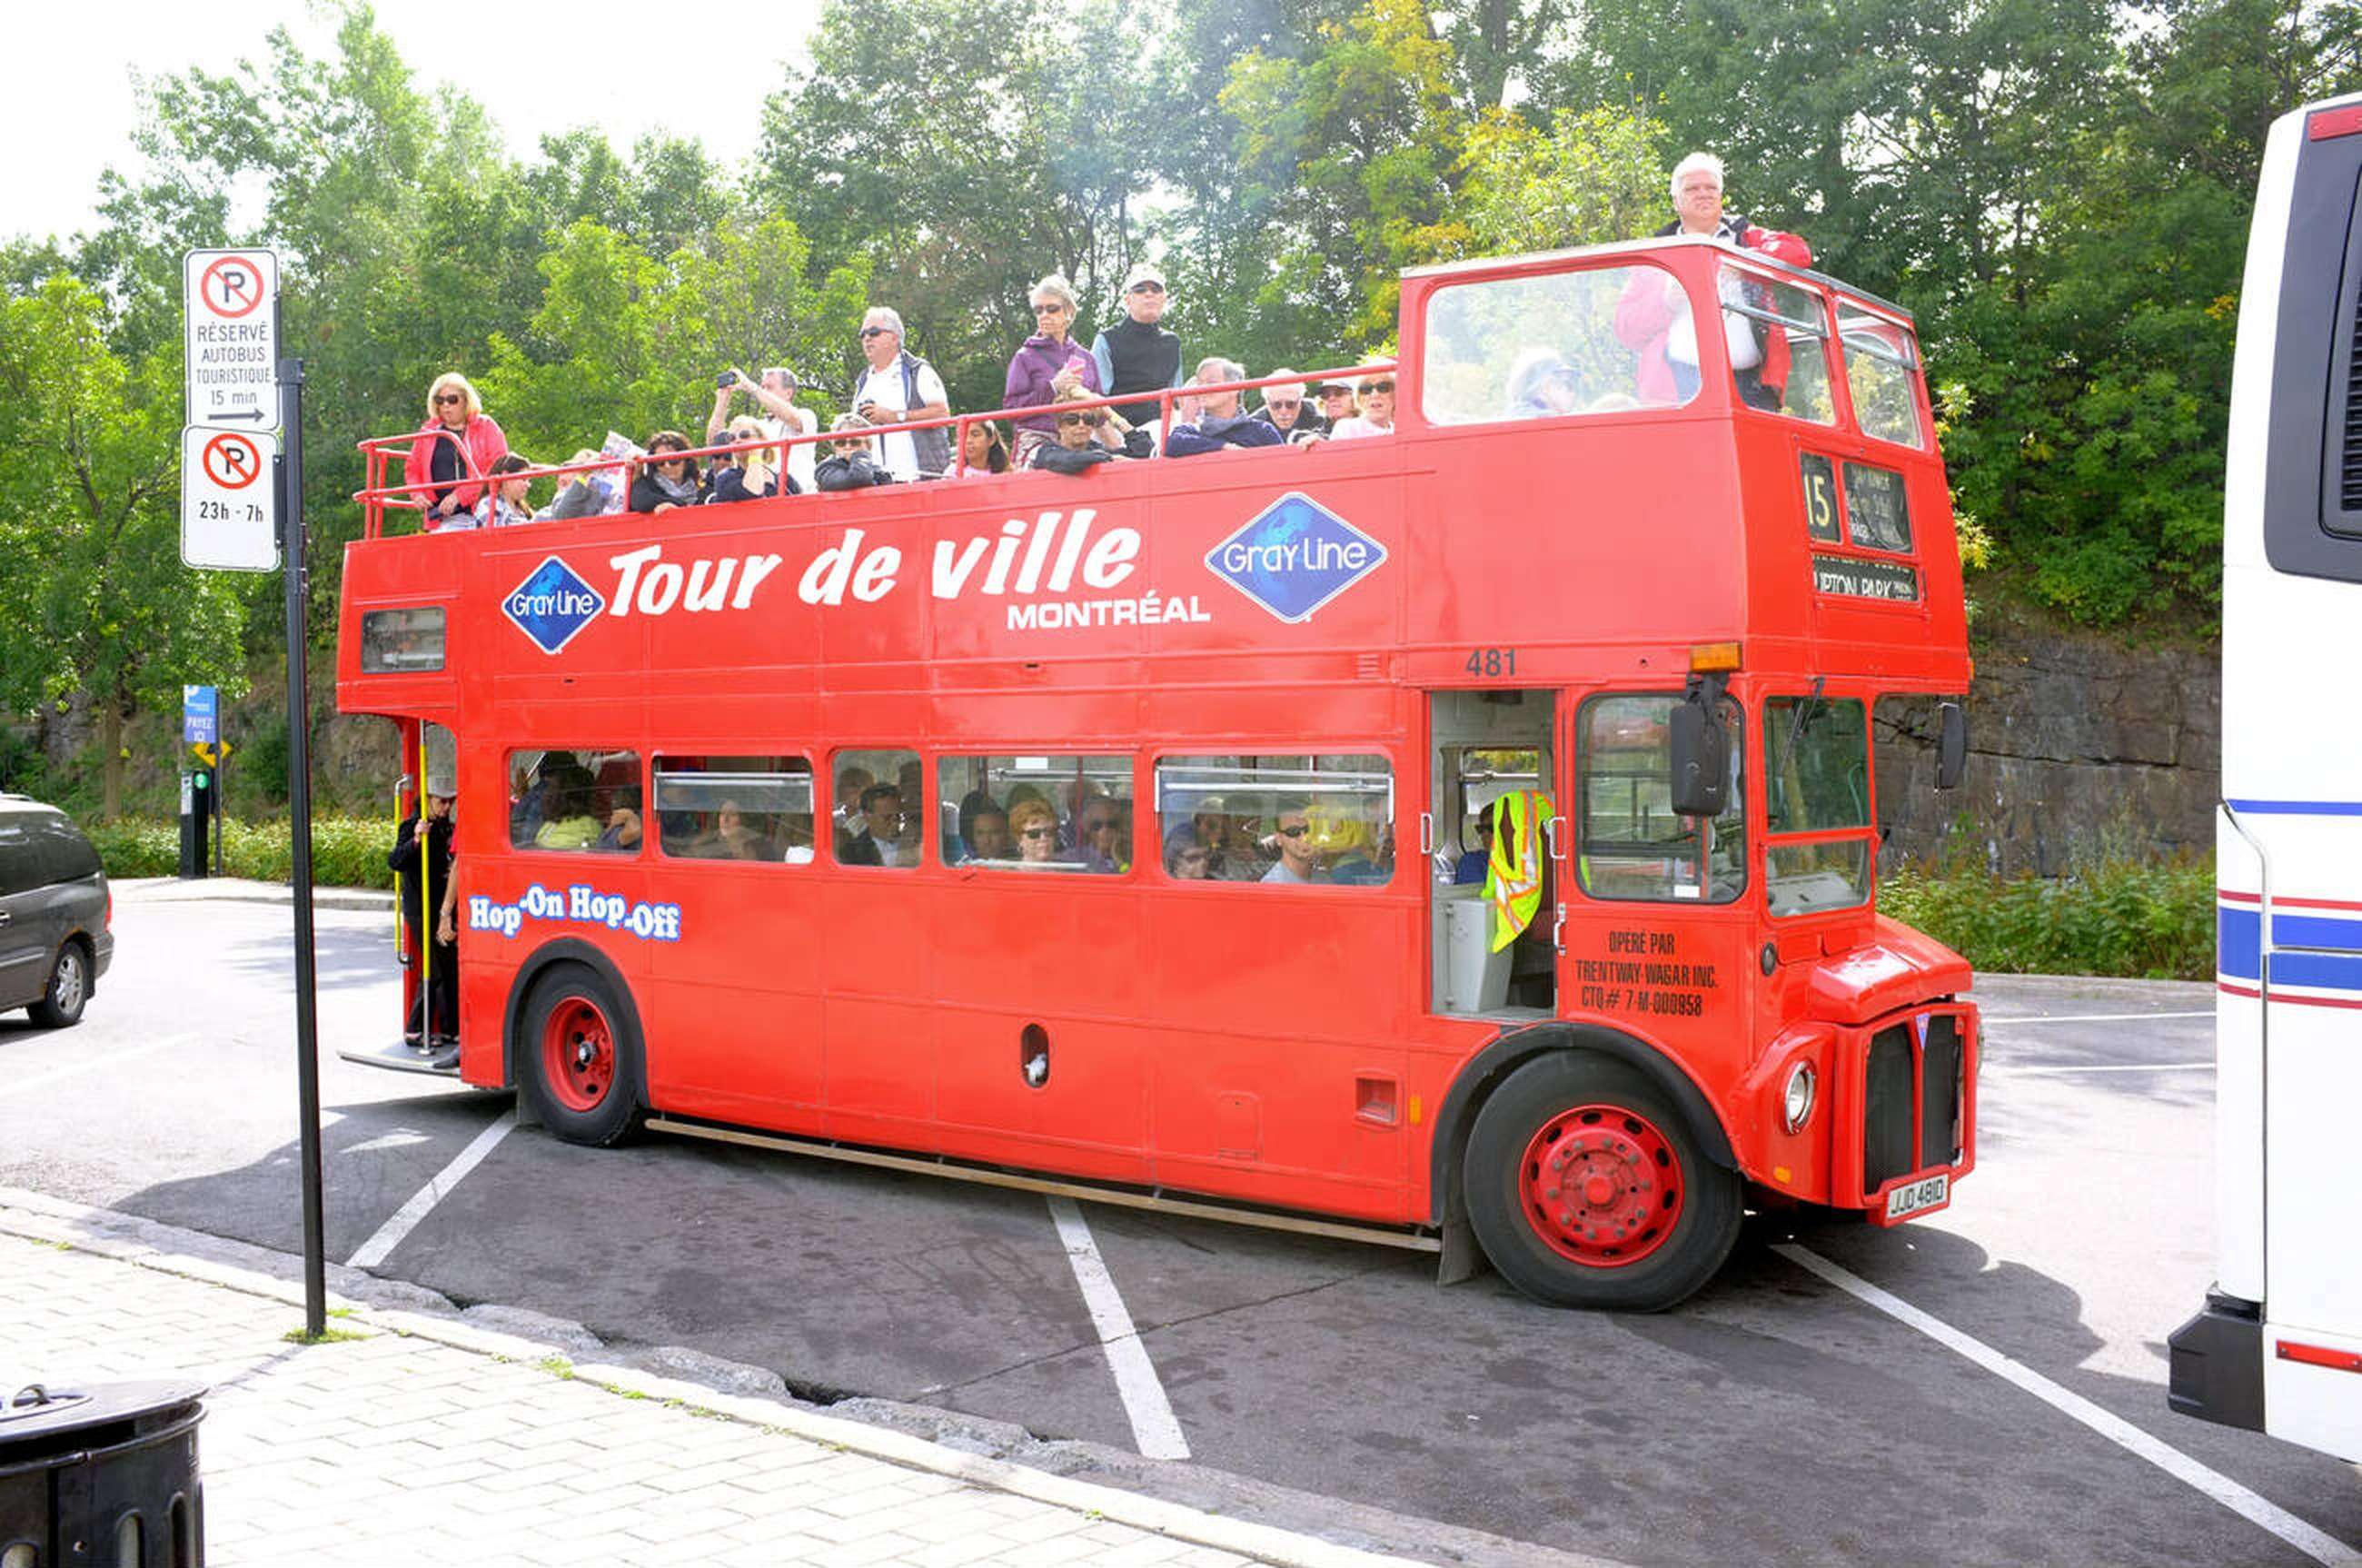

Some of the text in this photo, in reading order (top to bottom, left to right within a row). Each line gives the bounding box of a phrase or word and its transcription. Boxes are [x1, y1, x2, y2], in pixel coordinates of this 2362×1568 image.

[196, 321, 269, 342] RÉSERVÉ
[202, 346, 266, 363] AUTOBUS
[196, 367, 272, 384] TOURISTIQUE
[210, 390, 258, 406] 15 min
[1803, 473, 1831, 527] 15
[200, 501, 229, 521] 23h
[246, 503, 264, 522] 7h
[610, 509, 1142, 616] Tour de ville
[1006, 590, 1212, 630] MONTRÉAL
[1464, 647, 1516, 678] 481
[1650, 933, 1675, 955] PAR
[1692, 965, 1720, 989] INC.
